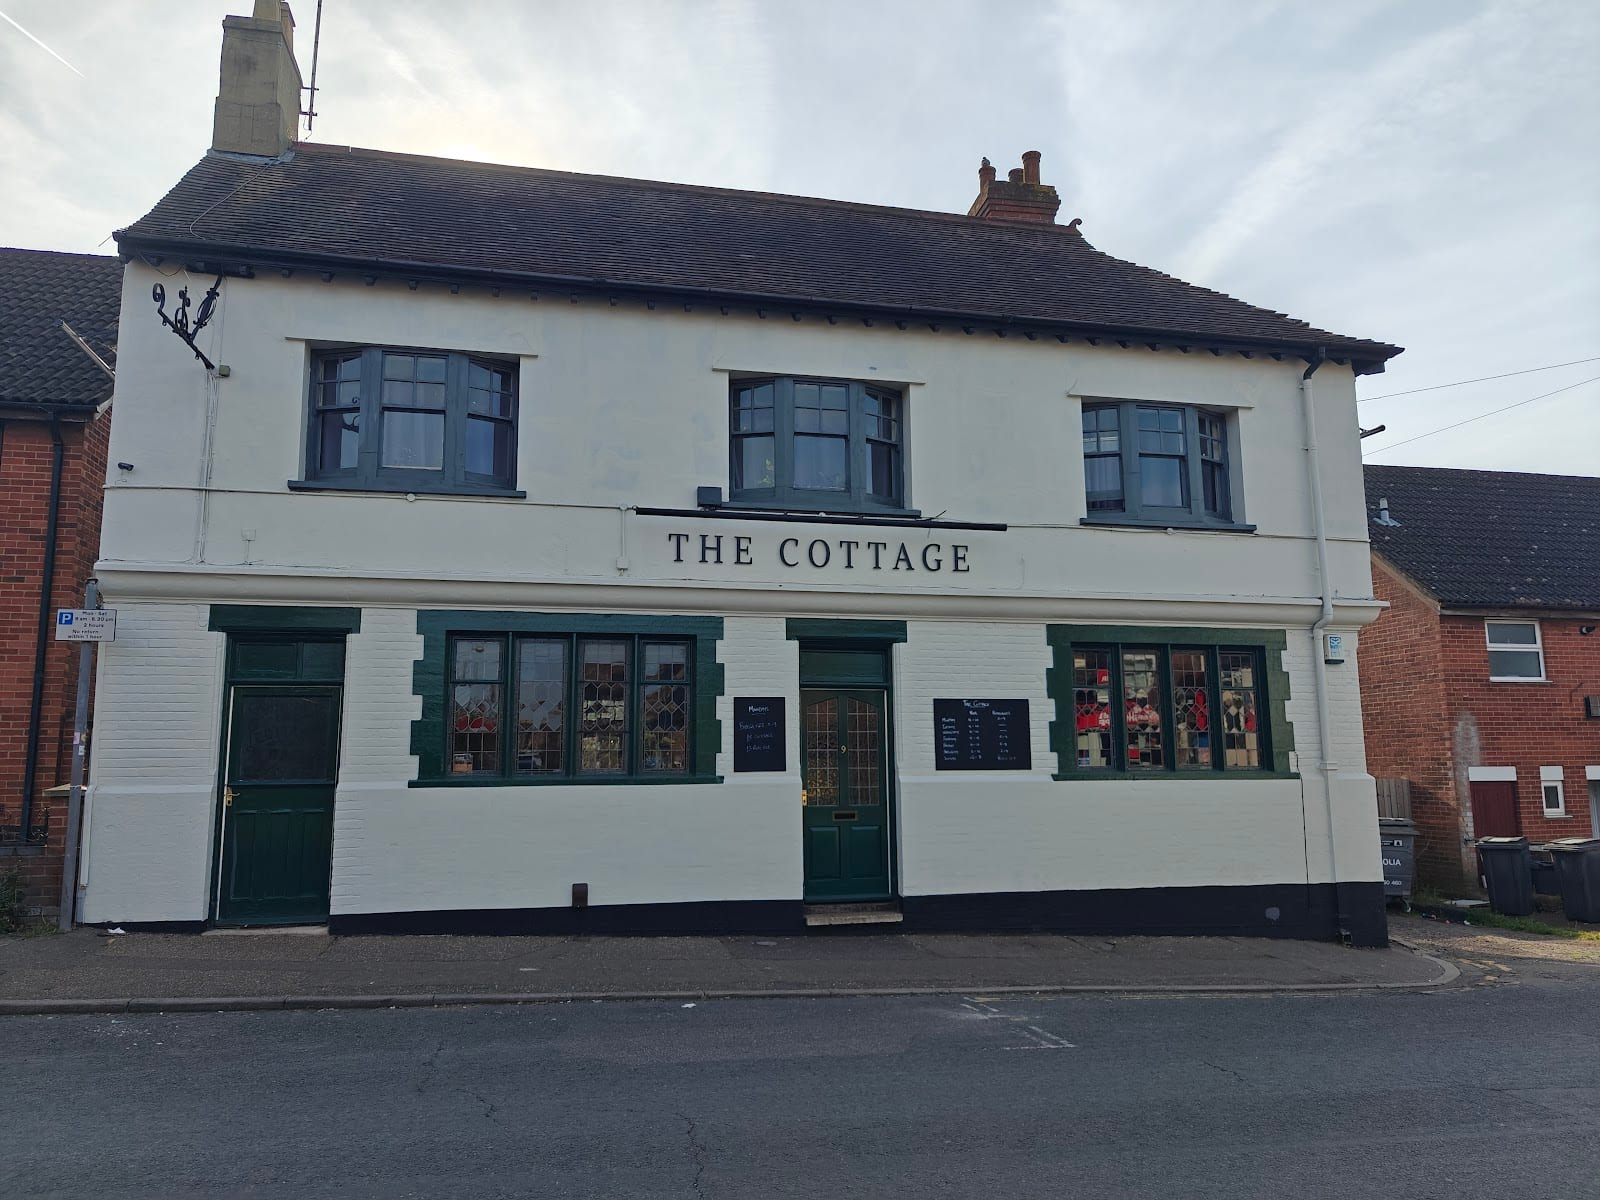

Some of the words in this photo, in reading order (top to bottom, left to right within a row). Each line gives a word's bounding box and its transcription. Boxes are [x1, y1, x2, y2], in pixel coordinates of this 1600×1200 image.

[668, 533, 753, 565] THE
[779, 538, 970, 572] COTTAGE
[62, 613, 72, 624] P
[841, 745, 847, 754] 9
[1383, 858, 1402, 866] OLIA
